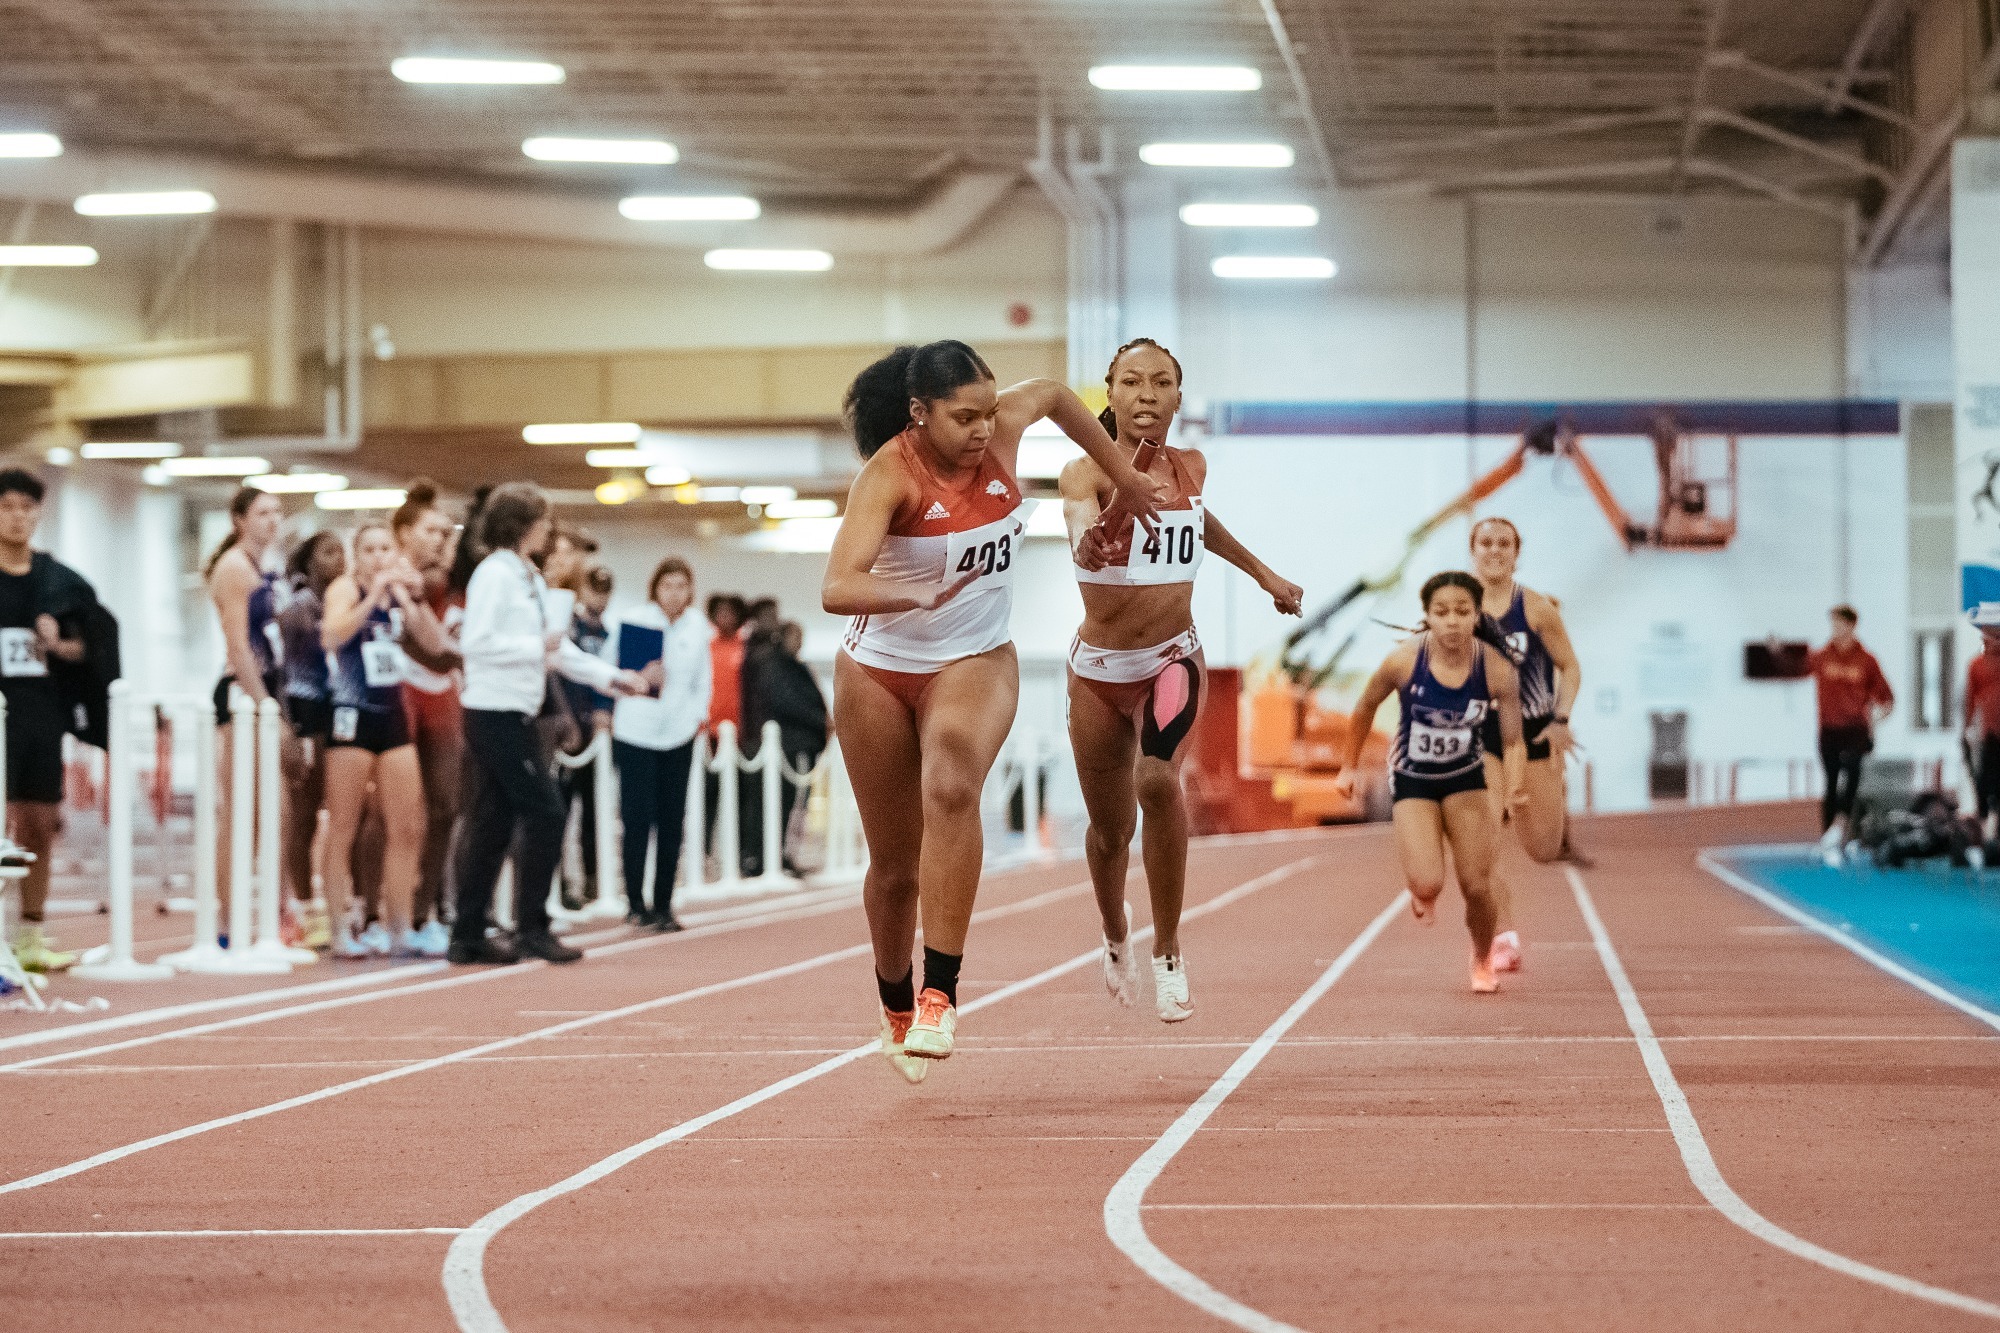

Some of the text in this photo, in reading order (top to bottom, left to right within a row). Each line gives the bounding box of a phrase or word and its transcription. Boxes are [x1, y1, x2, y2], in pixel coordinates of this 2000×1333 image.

[924, 511, 951, 520] adidas
[956, 534, 1010, 576] 403
[1142, 525, 1194, 564] 410
[1418, 733, 1460, 757] 353
